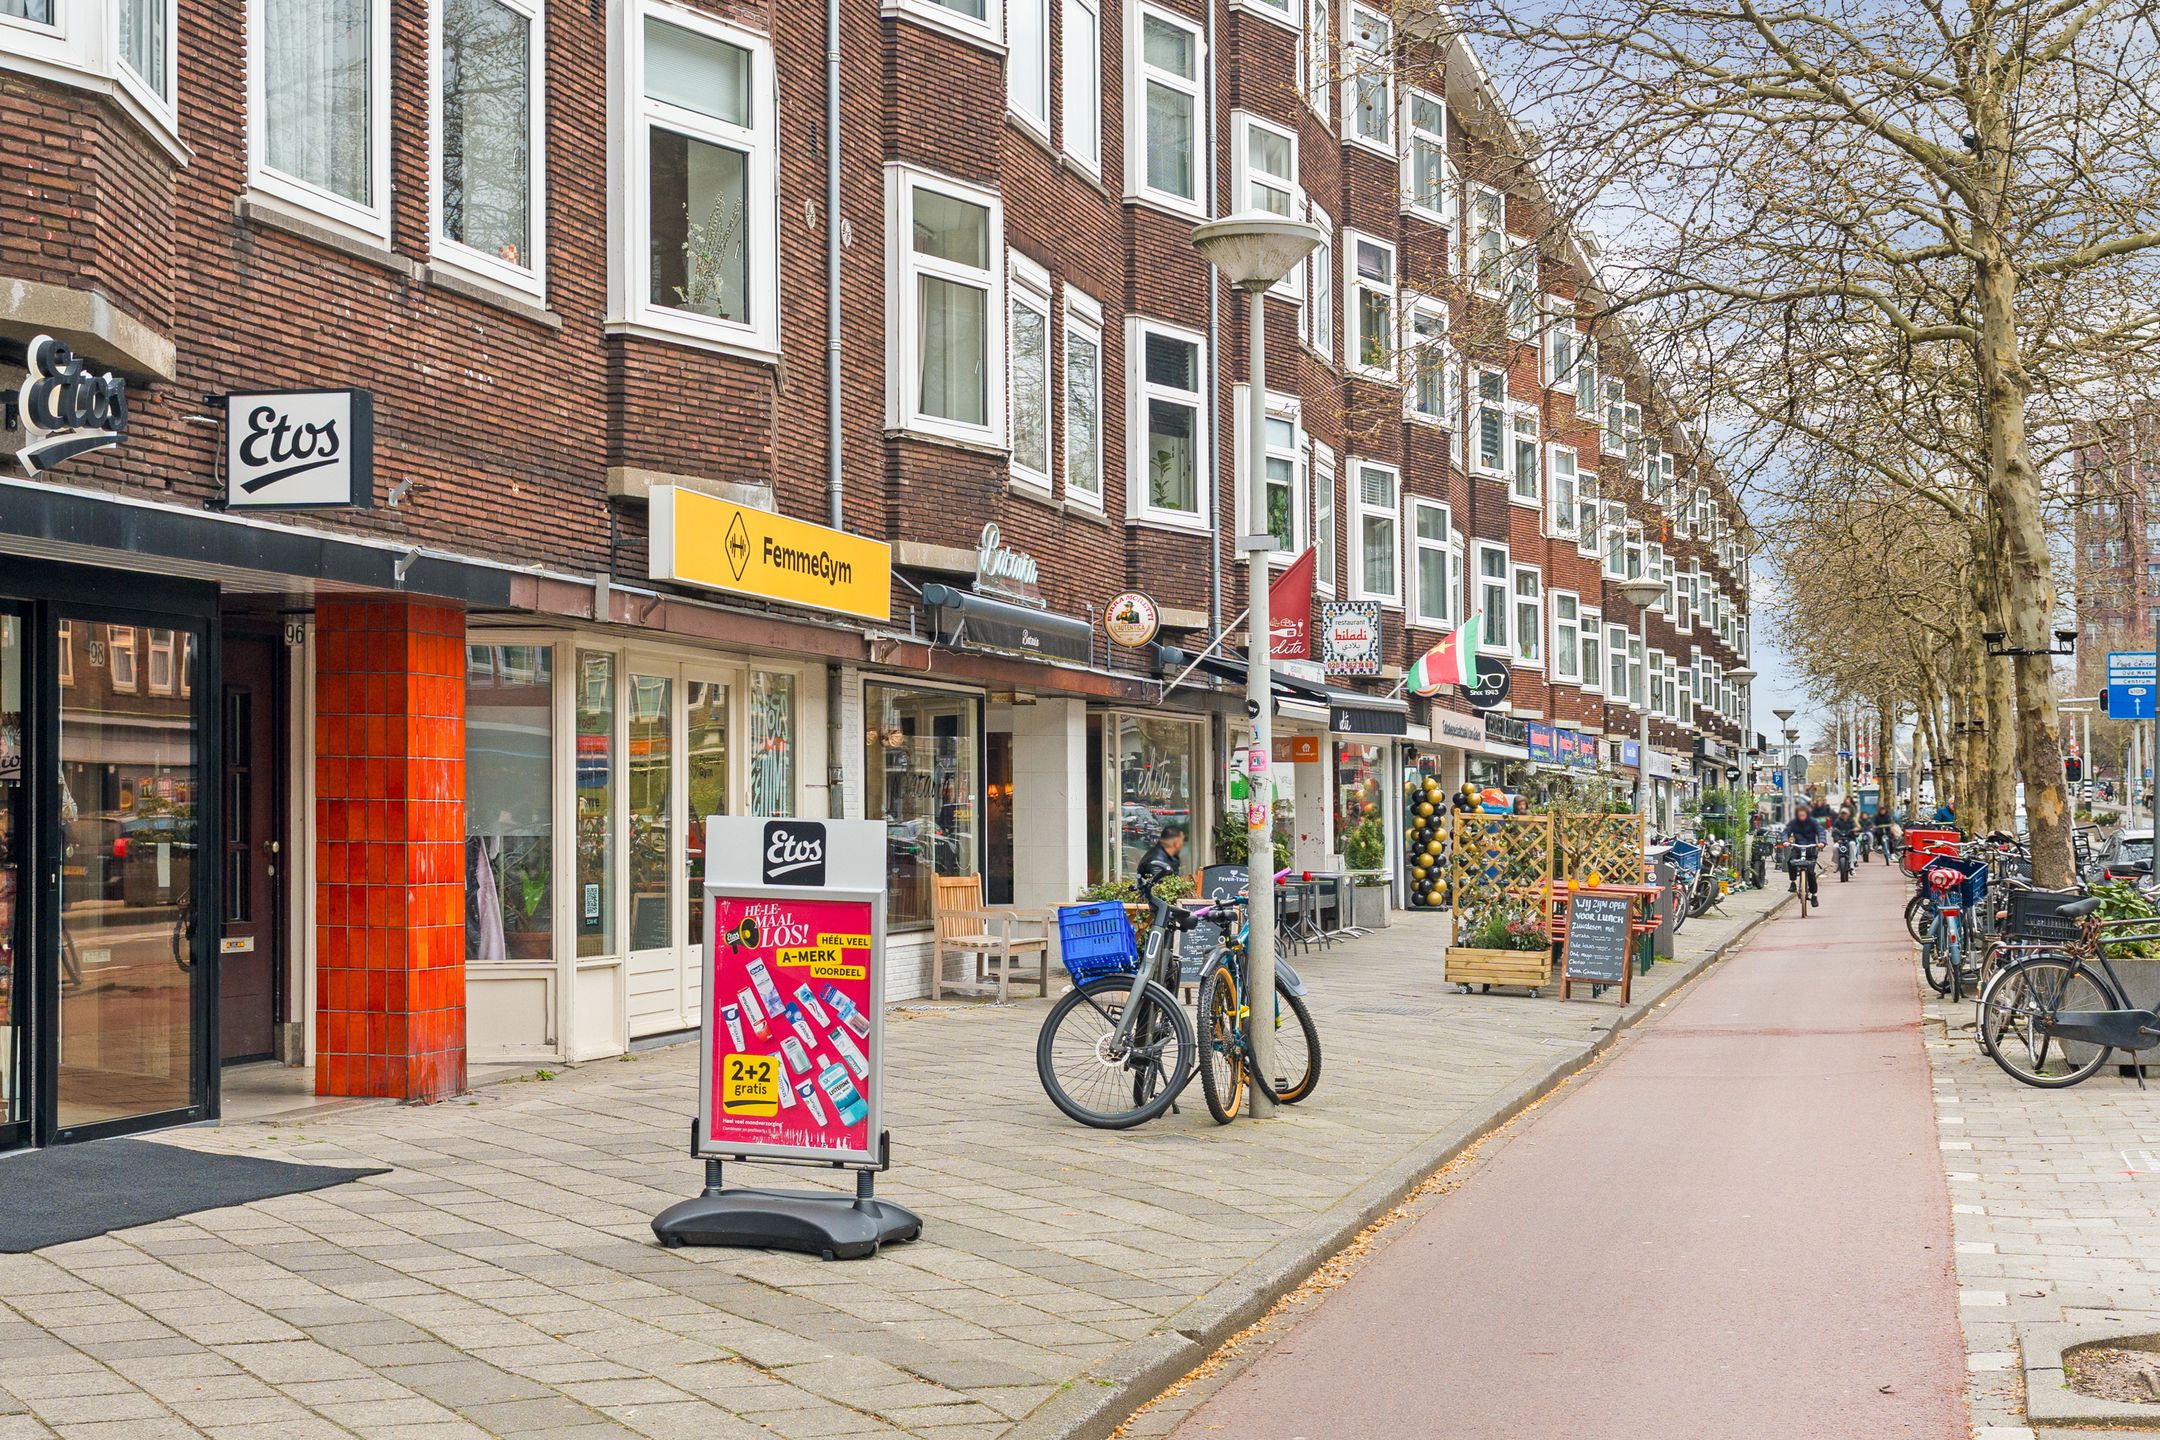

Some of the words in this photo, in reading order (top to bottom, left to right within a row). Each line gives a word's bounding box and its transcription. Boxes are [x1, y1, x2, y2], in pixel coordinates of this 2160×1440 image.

[19, 335, 129, 436] Etos
[239, 406, 340, 467] Etos
[763, 536, 852, 586] FemmeGym
[286, 623, 304, 643] 96
[1335, 628, 1367, 642] biladi
[91, 643, 105, 665] 98
[767, 830, 822, 864] Etos
[1575, 898, 1592, 911] WIJ
[1593, 900, 1608, 913] ZIJN
[1609, 901, 1627, 911] OPEN
[755, 913, 795, 928] MAAL
[1575, 913, 1595, 921] VOOR
[760, 924, 809, 948] LOS!
[821, 935, 844, 946] HÉÉL
[847, 937, 869, 947] VEEL
[782, 950, 836, 963] A-MERK
[815, 966, 862, 977] VOORDEEL
[731, 1060, 771, 1083] 2+2
[734, 1083, 767, 1096] gratis
